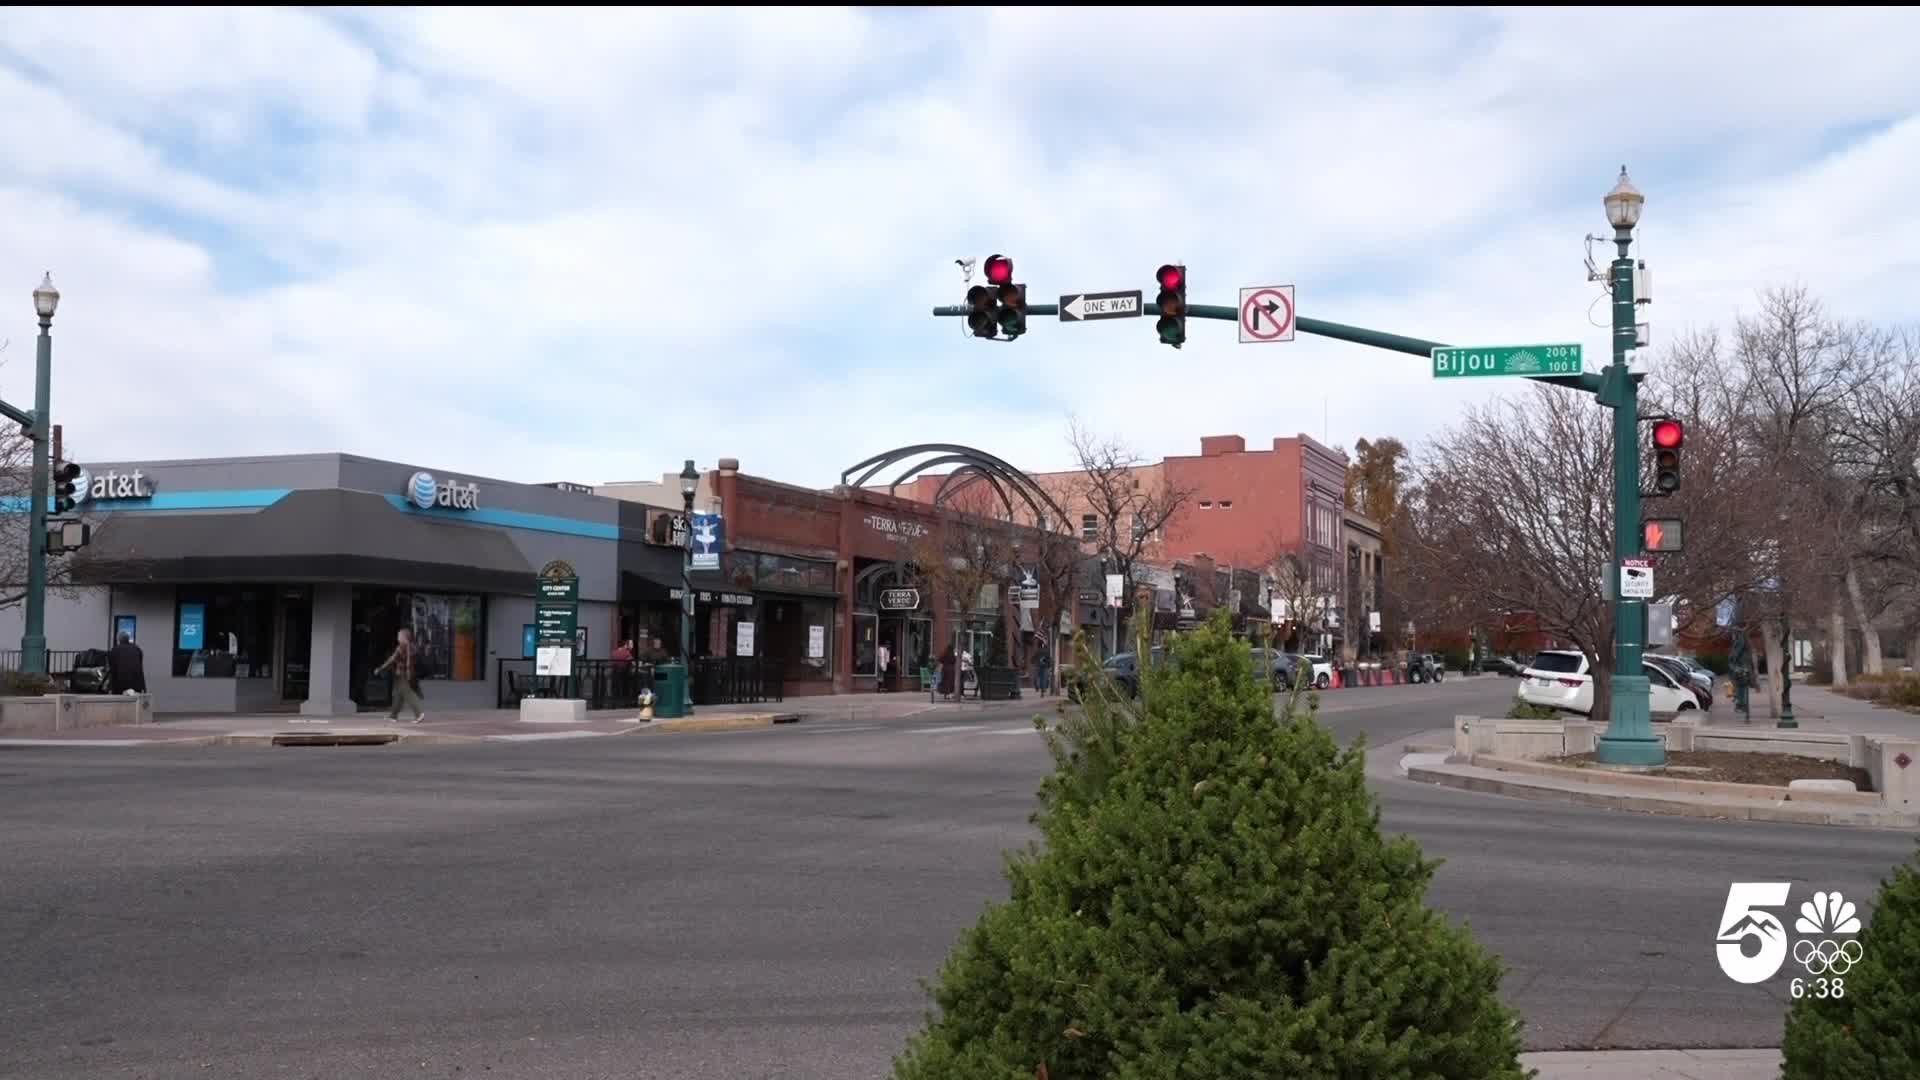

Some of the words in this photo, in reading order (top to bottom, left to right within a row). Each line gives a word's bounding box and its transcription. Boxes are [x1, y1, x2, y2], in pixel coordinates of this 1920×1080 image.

[1084, 300, 1105, 313] ONE
[1110, 298, 1134, 311] WAY
[1546, 347, 1568, 358] 200
[1569, 347, 1578, 357] N
[1436, 351, 1496, 375] Bijou
[1549, 361, 1568, 372] 100
[1571, 361, 1577, 371] E
[91, 469, 144, 498] at&t
[437, 479, 481, 511] at&t
[871, 515, 898, 534] TERRA
[1624, 559, 1649, 568] NOTICE
[889, 591, 912, 599] TERRA
